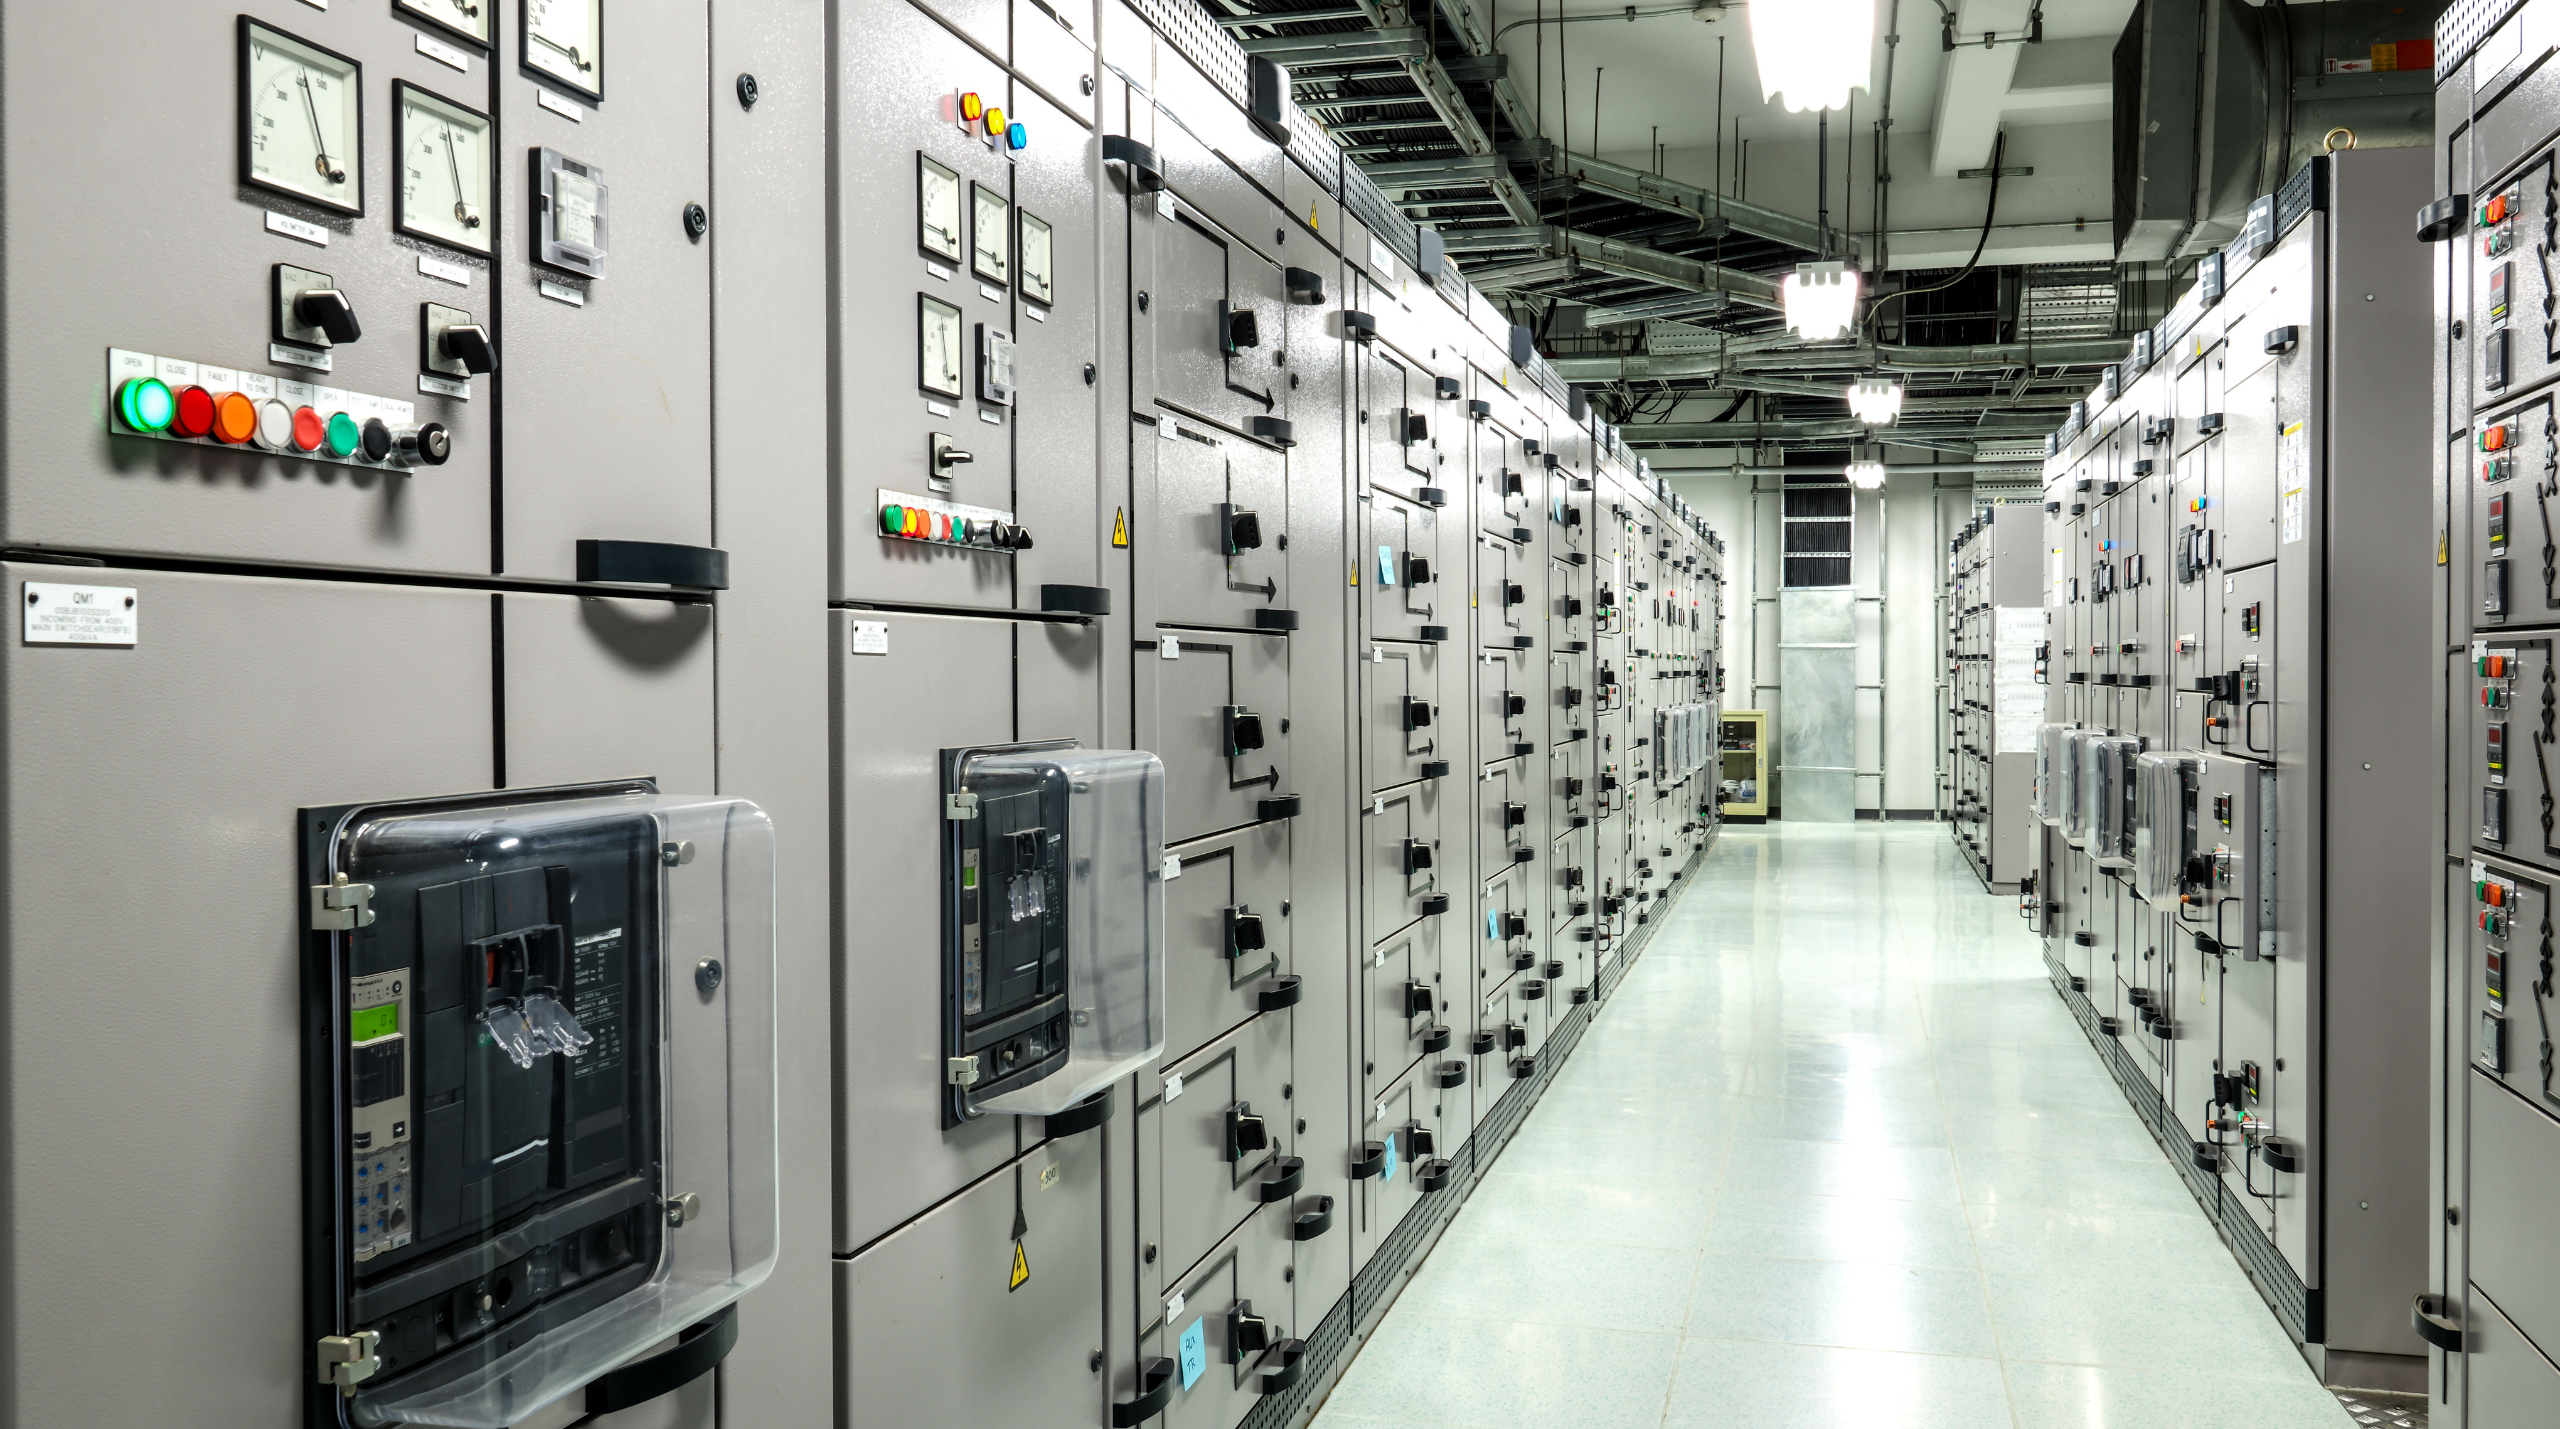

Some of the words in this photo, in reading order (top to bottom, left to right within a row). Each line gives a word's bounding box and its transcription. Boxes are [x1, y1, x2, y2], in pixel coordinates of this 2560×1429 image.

[254, 44, 264, 61] V
[316, 78, 328, 91] 500
[276, 89, 288, 102] 300
[405, 104, 413, 119] V
[262, 117, 274, 129] 200
[439, 131, 448, 142] 400
[456, 132, 465, 143] 500
[259, 142, 265, 151] 0
[423, 144, 433, 155] 300
[411, 169, 421, 180] 200
[280, 220, 305, 234] VOLTMETER
[123, 356, 143, 368] OPEN
[286, 351, 306, 361] SELECTOR
[166, 363, 187, 376] CLOSE
[207, 370, 228, 382] FAULT
[248, 373, 266, 384] READY
[245, 382, 254, 391] TO
[255, 384, 269, 395] SYNC
[286, 385, 304, 396] CLOSE
[323, 392, 338, 402] OPEN
[72, 592, 94, 604] QM1
[39, 615, 77, 624] INCOMING
[80, 616, 101, 624] FROM
[105, 617, 124, 625] 400V
[31, 623, 51, 631] MAIN
[381, 1014, 386, 1027] 0
[1186, 1357, 1196, 1373] TR
